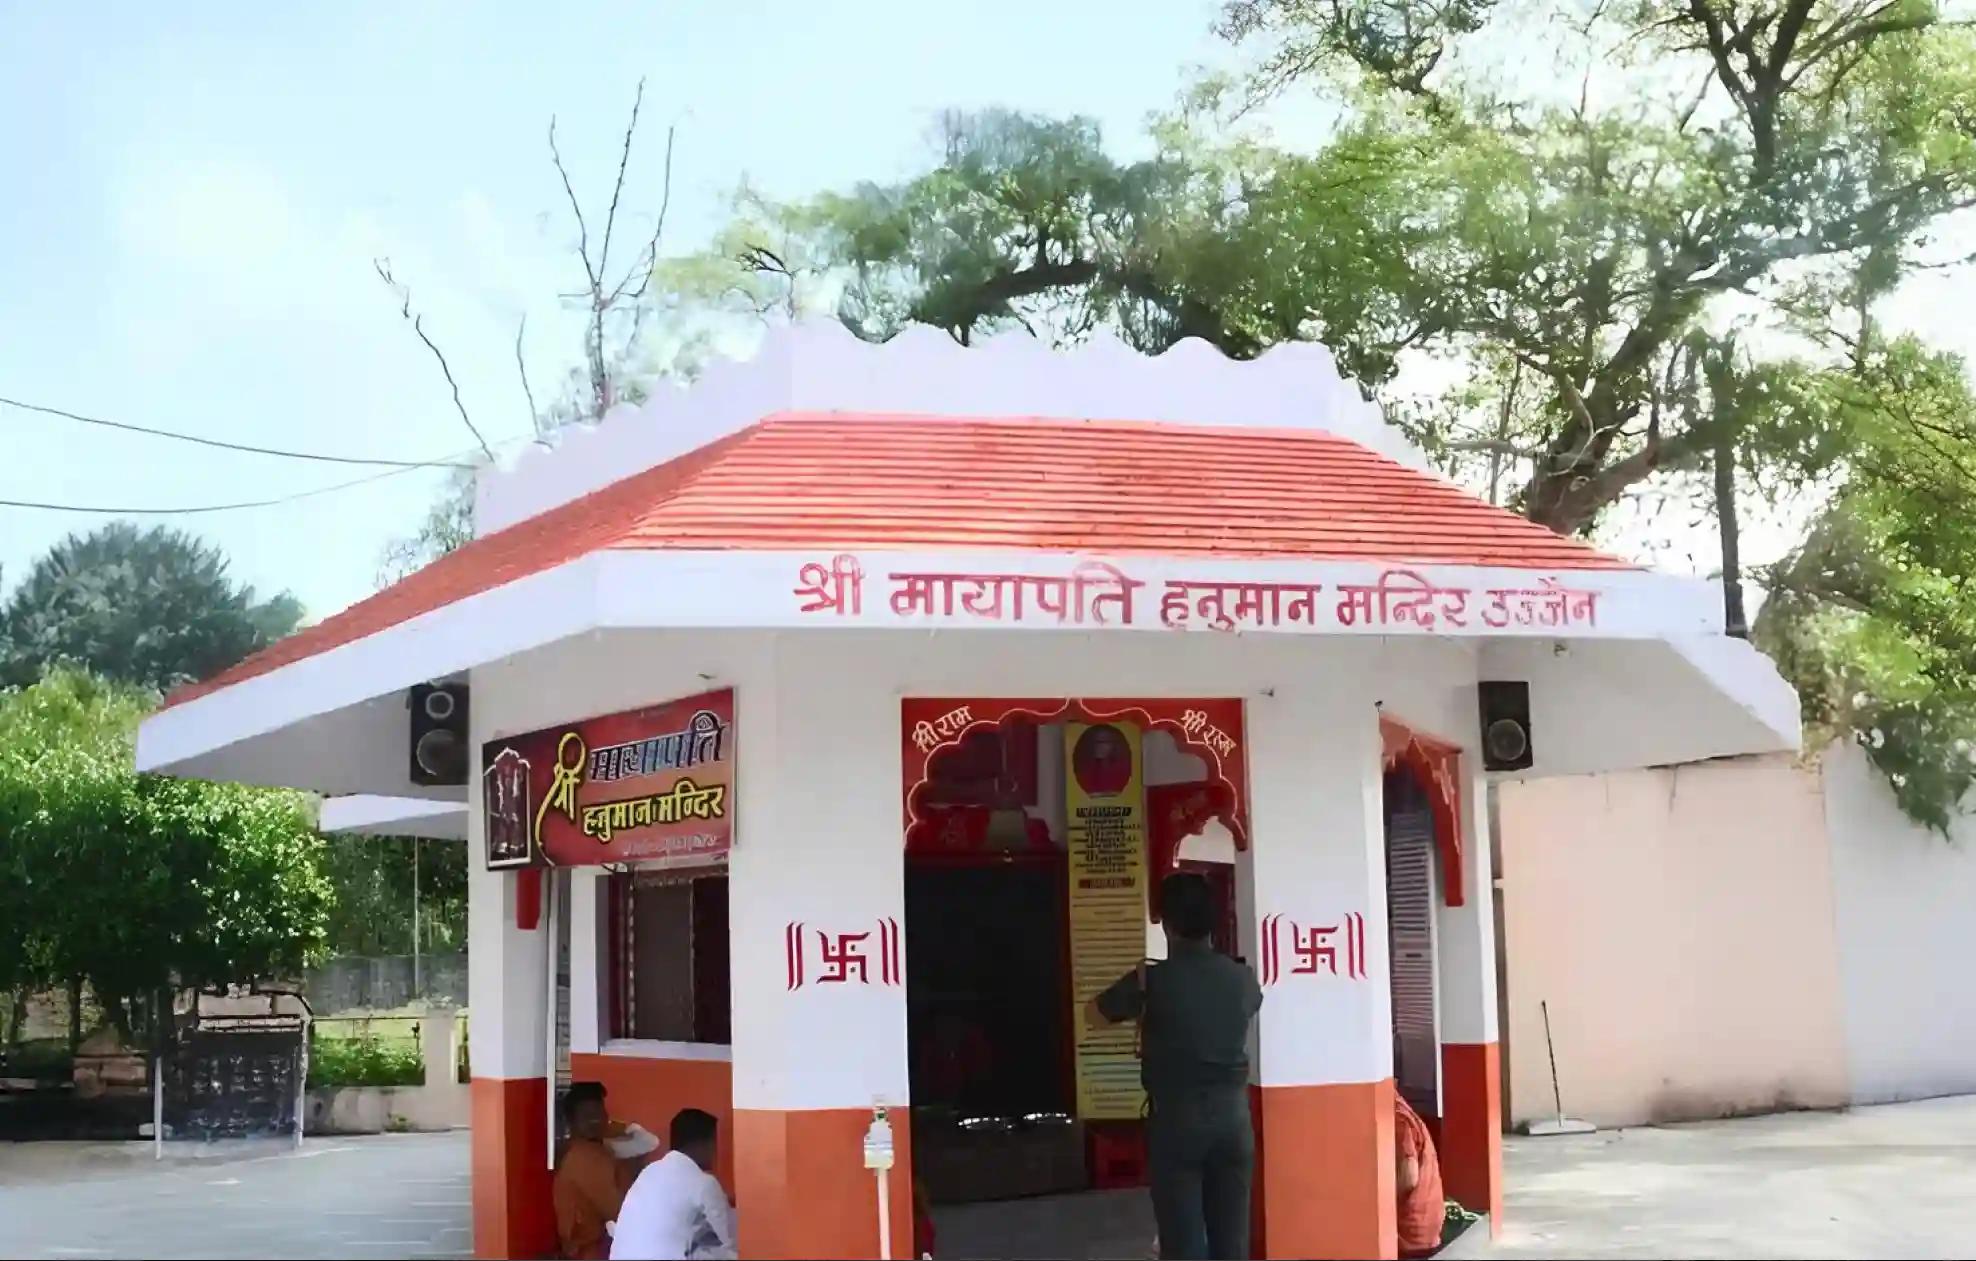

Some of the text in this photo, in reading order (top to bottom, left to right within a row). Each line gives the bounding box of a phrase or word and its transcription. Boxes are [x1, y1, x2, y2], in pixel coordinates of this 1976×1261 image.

[793, 554, 865, 616] श्री
[888, 560, 1146, 625] मायापति
[1159, 580, 1323, 635] हनुमान
[1336, 569, 1472, 632] मन्दिर
[534, 732, 586, 867] श्री
